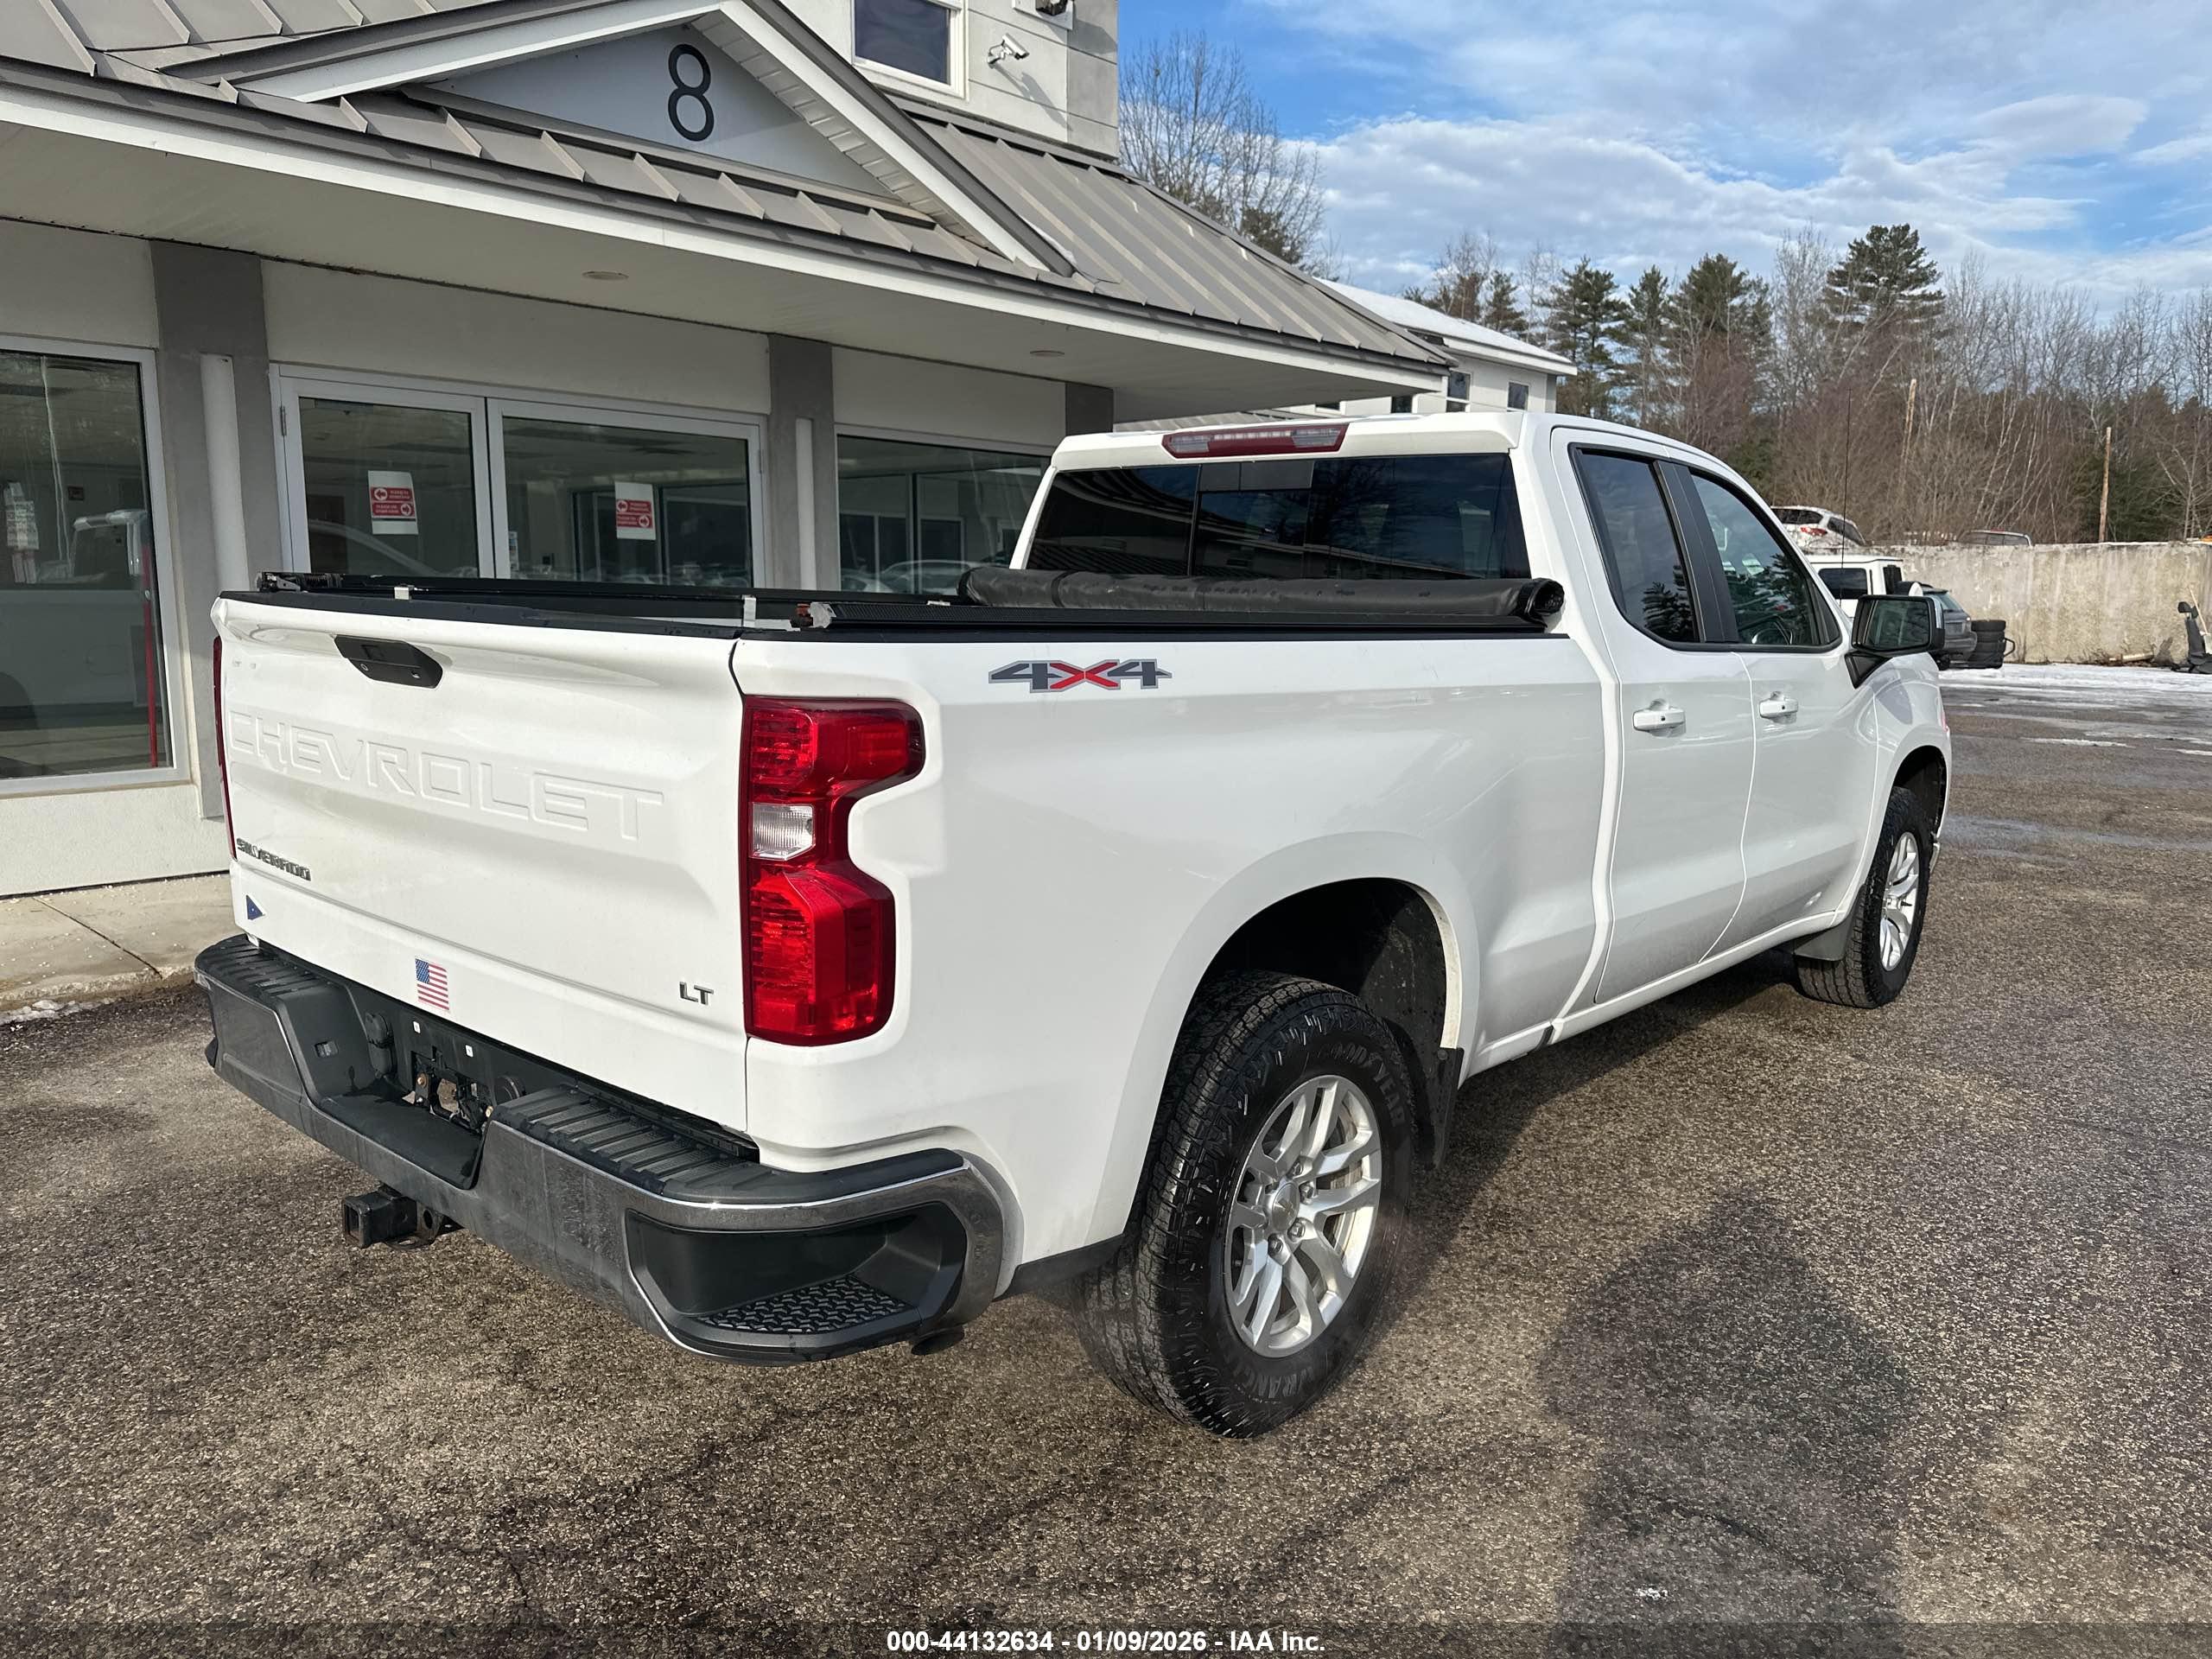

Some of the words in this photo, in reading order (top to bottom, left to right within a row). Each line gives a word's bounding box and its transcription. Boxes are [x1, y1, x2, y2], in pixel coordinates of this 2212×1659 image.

[668, 43, 715, 142] 8
[988, 658, 1173, 693] 4X4
[227, 709, 664, 842] CHEVROLET
[236, 837, 312, 881] SILVERADO
[679, 981, 715, 1006] LT
